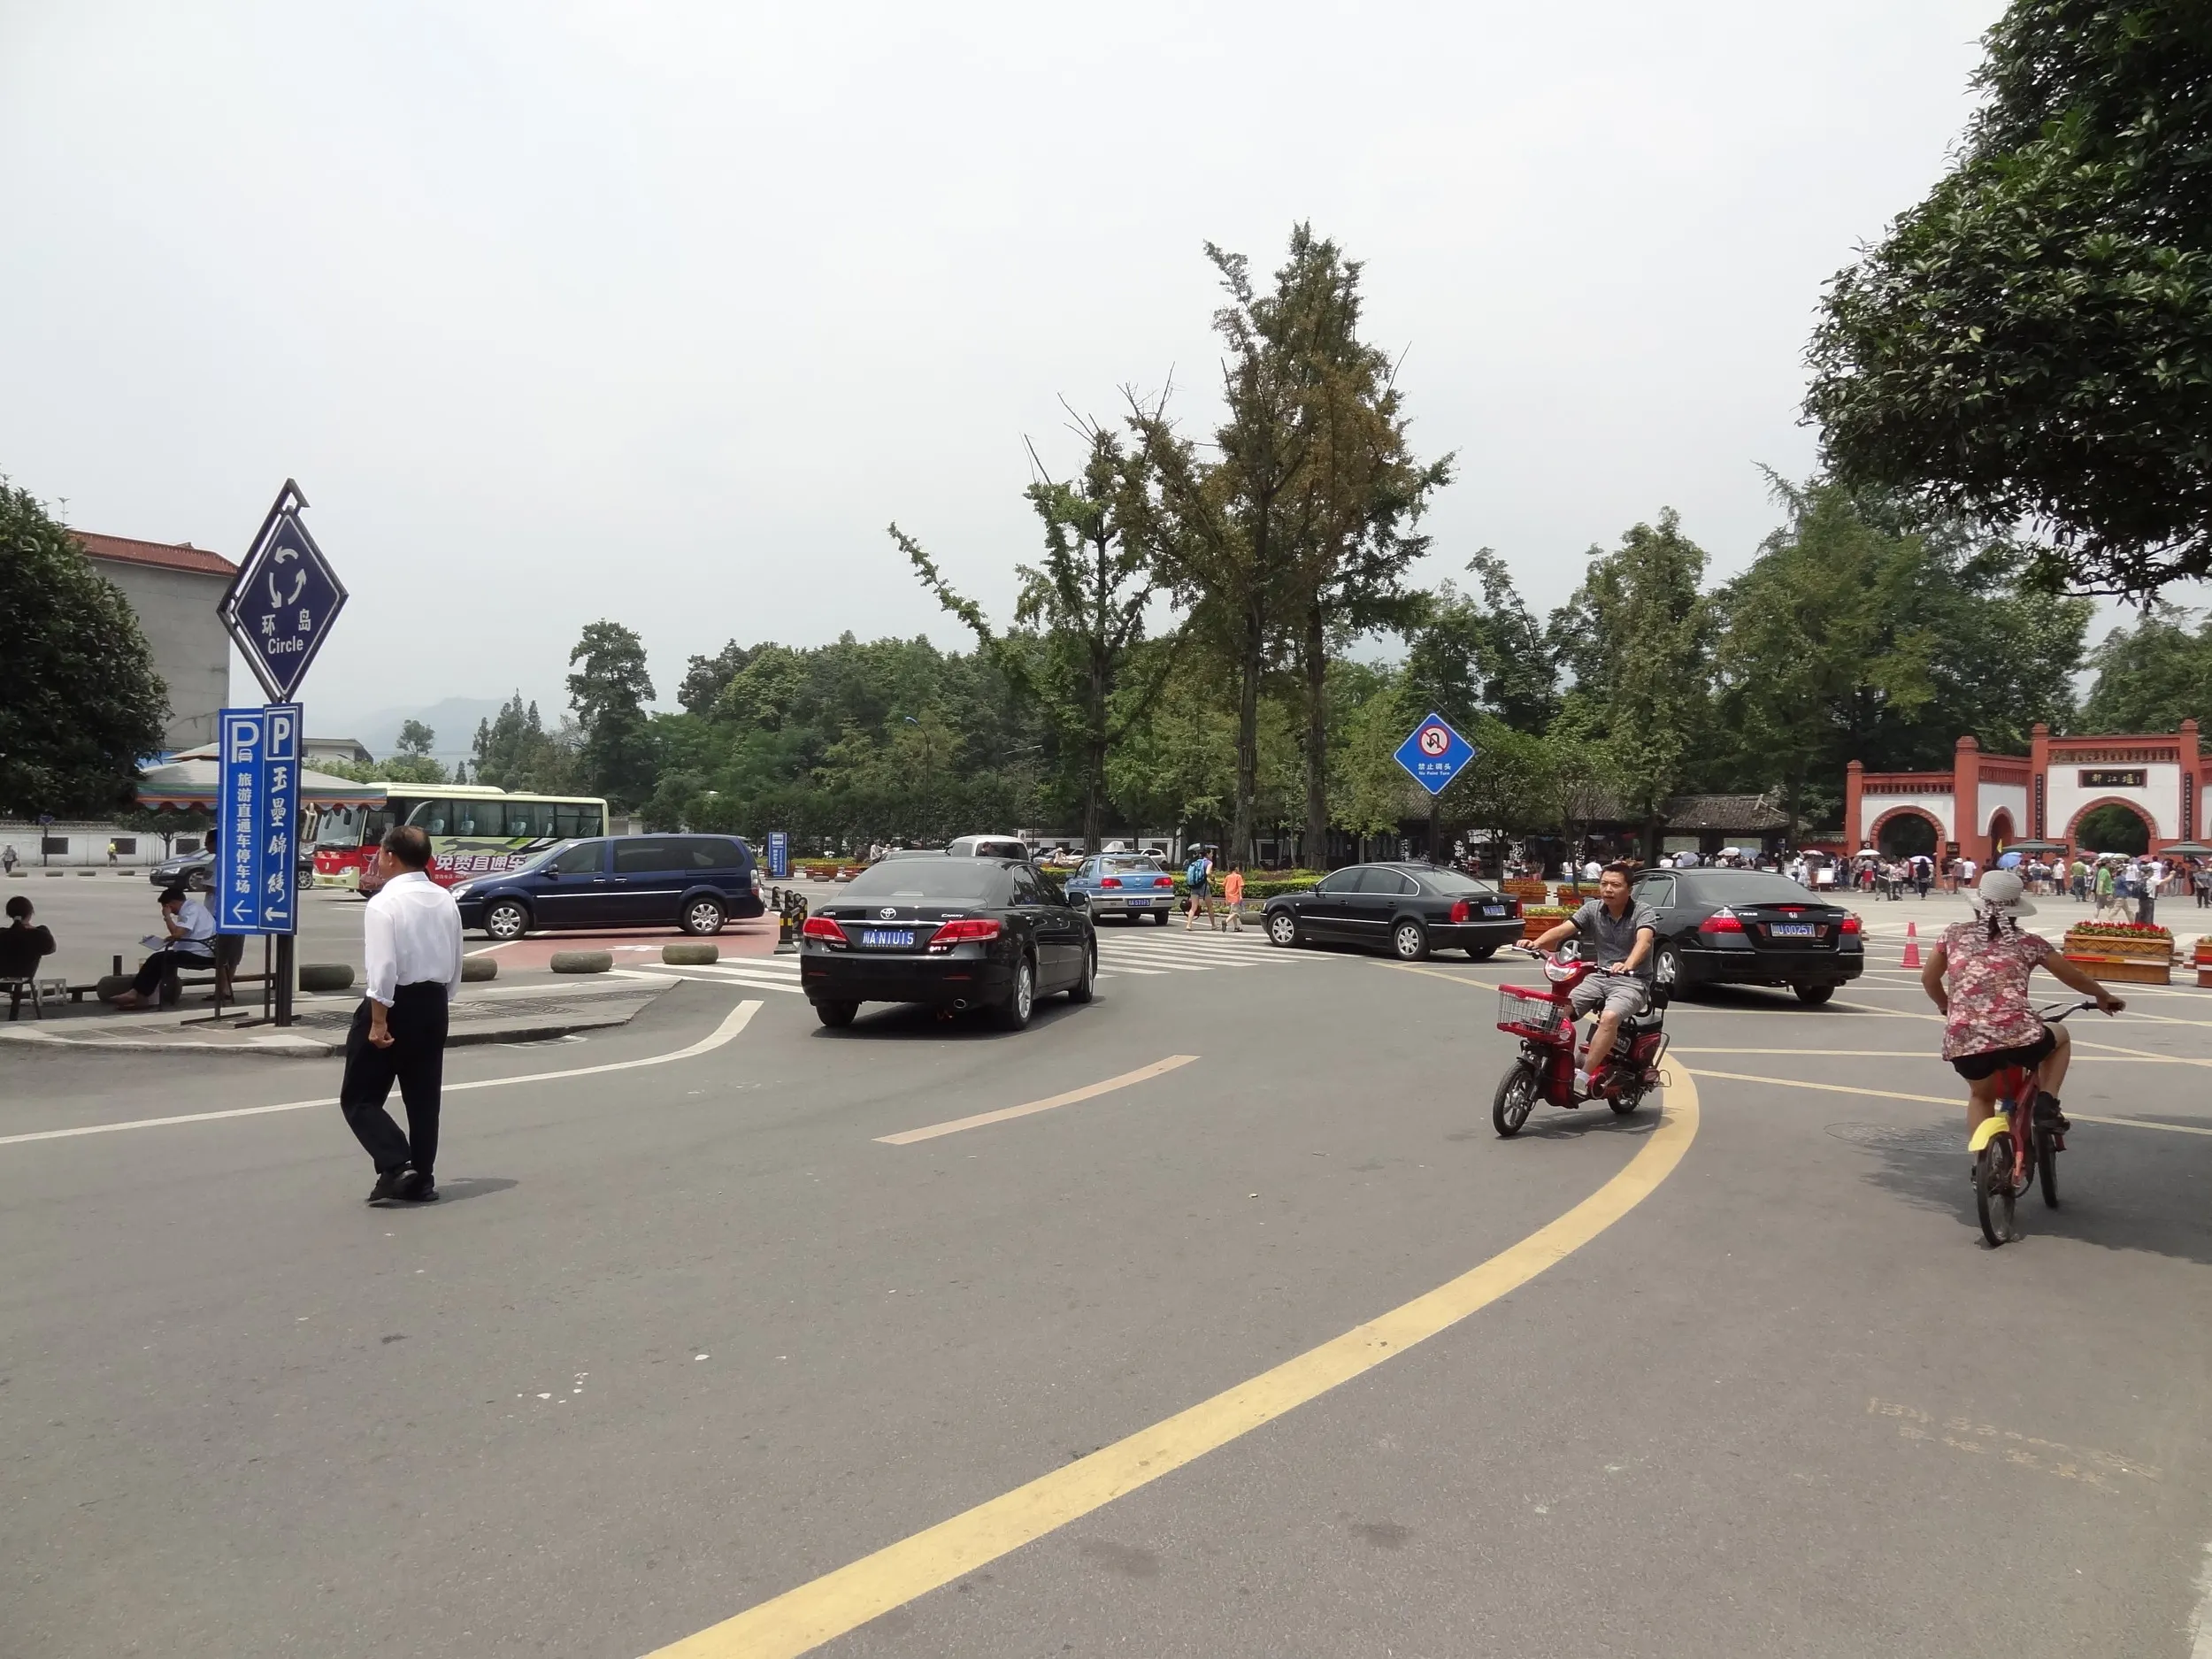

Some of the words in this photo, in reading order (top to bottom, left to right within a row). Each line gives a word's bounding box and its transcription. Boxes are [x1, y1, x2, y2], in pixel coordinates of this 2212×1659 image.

[262, 609, 311, 636] 环岛
[268, 636, 303, 654] Circle
[231, 721, 259, 764] P
[273, 718, 290, 754] P
[235, 772, 253, 894] 旅游直通车停车场
[434, 855, 526, 871] 免费直通车
